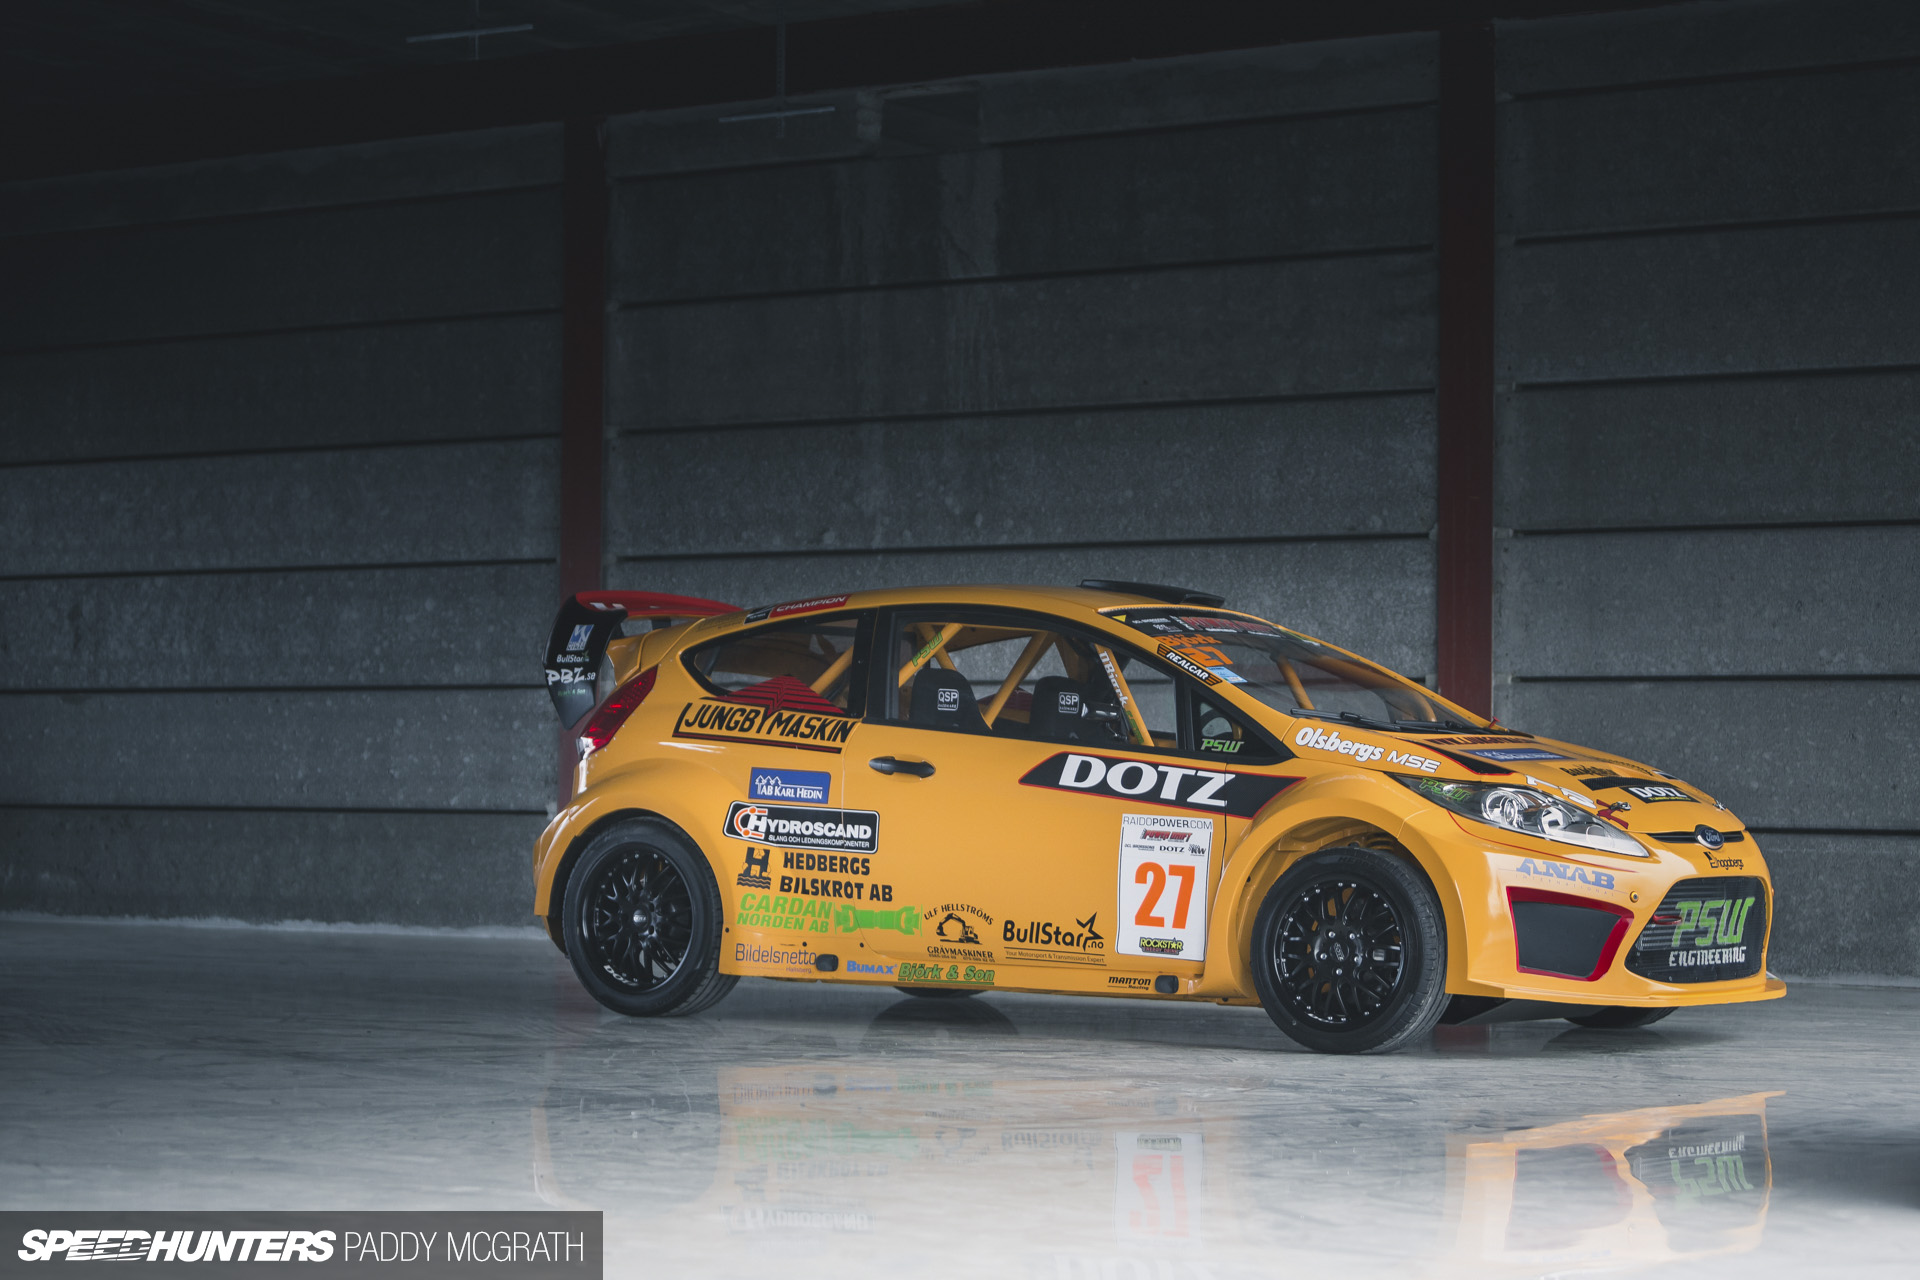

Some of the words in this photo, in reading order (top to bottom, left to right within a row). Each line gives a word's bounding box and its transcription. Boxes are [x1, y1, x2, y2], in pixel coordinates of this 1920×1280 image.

[777, 596, 846, 612] CHAMPION
[1166, 651, 1209, 680] REALCAR
[938, 691, 958, 702] QSP
[1059, 694, 1078, 705] QSP
[1200, 739, 1245, 752] PSW
[1295, 727, 1385, 762] Olsbergs
[1387, 751, 1442, 774] MSE
[1058, 754, 1235, 807] DOTZ
[1419, 777, 1472, 803] PSW
[761, 786, 773, 797] AB
[1628, 786, 1688, 798] DOTZ
[747, 815, 872, 840] HYDROSCAND
[1122, 815, 1213, 830] RAIDOPOWER.COM
[768, 835, 788, 843] SLANG
[788, 836, 801, 844] OCH
[801, 837, 870, 849] LEDNINGSKOMPONENTER
[1144, 830, 1171, 840] POWER
[1705, 830, 1720, 841] Ford
[1159, 845, 1185, 853] DOTZ
[783, 852, 870, 876] HEDBERGS
[1516, 857, 1615, 890] ANAB
[779, 875, 864, 900] BILSKROT
[869, 883, 893, 902] AB
[1134, 861, 1195, 930] 27
[740, 893, 832, 920] CARDAN
[924, 907, 938, 920] ULF
[941, 903, 993, 925] HELLSTRÖMS
[736, 912, 805, 930] NORDEN
[809, 919, 829, 933] AB
[1671, 897, 1755, 948] PSW
[735, 943, 817, 965] Bildelsnetto
[926, 944, 993, 959] GRÄVMASKINER
[1018, 951, 1048, 959] Motorsport
[1053, 953, 1086, 961] Transmission
[1087, 956, 1104, 964] Expert
[1668, 946, 1747, 967] ENGINEERING
[899, 962, 943, 980] Björk
[946, 964, 959, 980] &
[963, 965, 995, 982] Son
